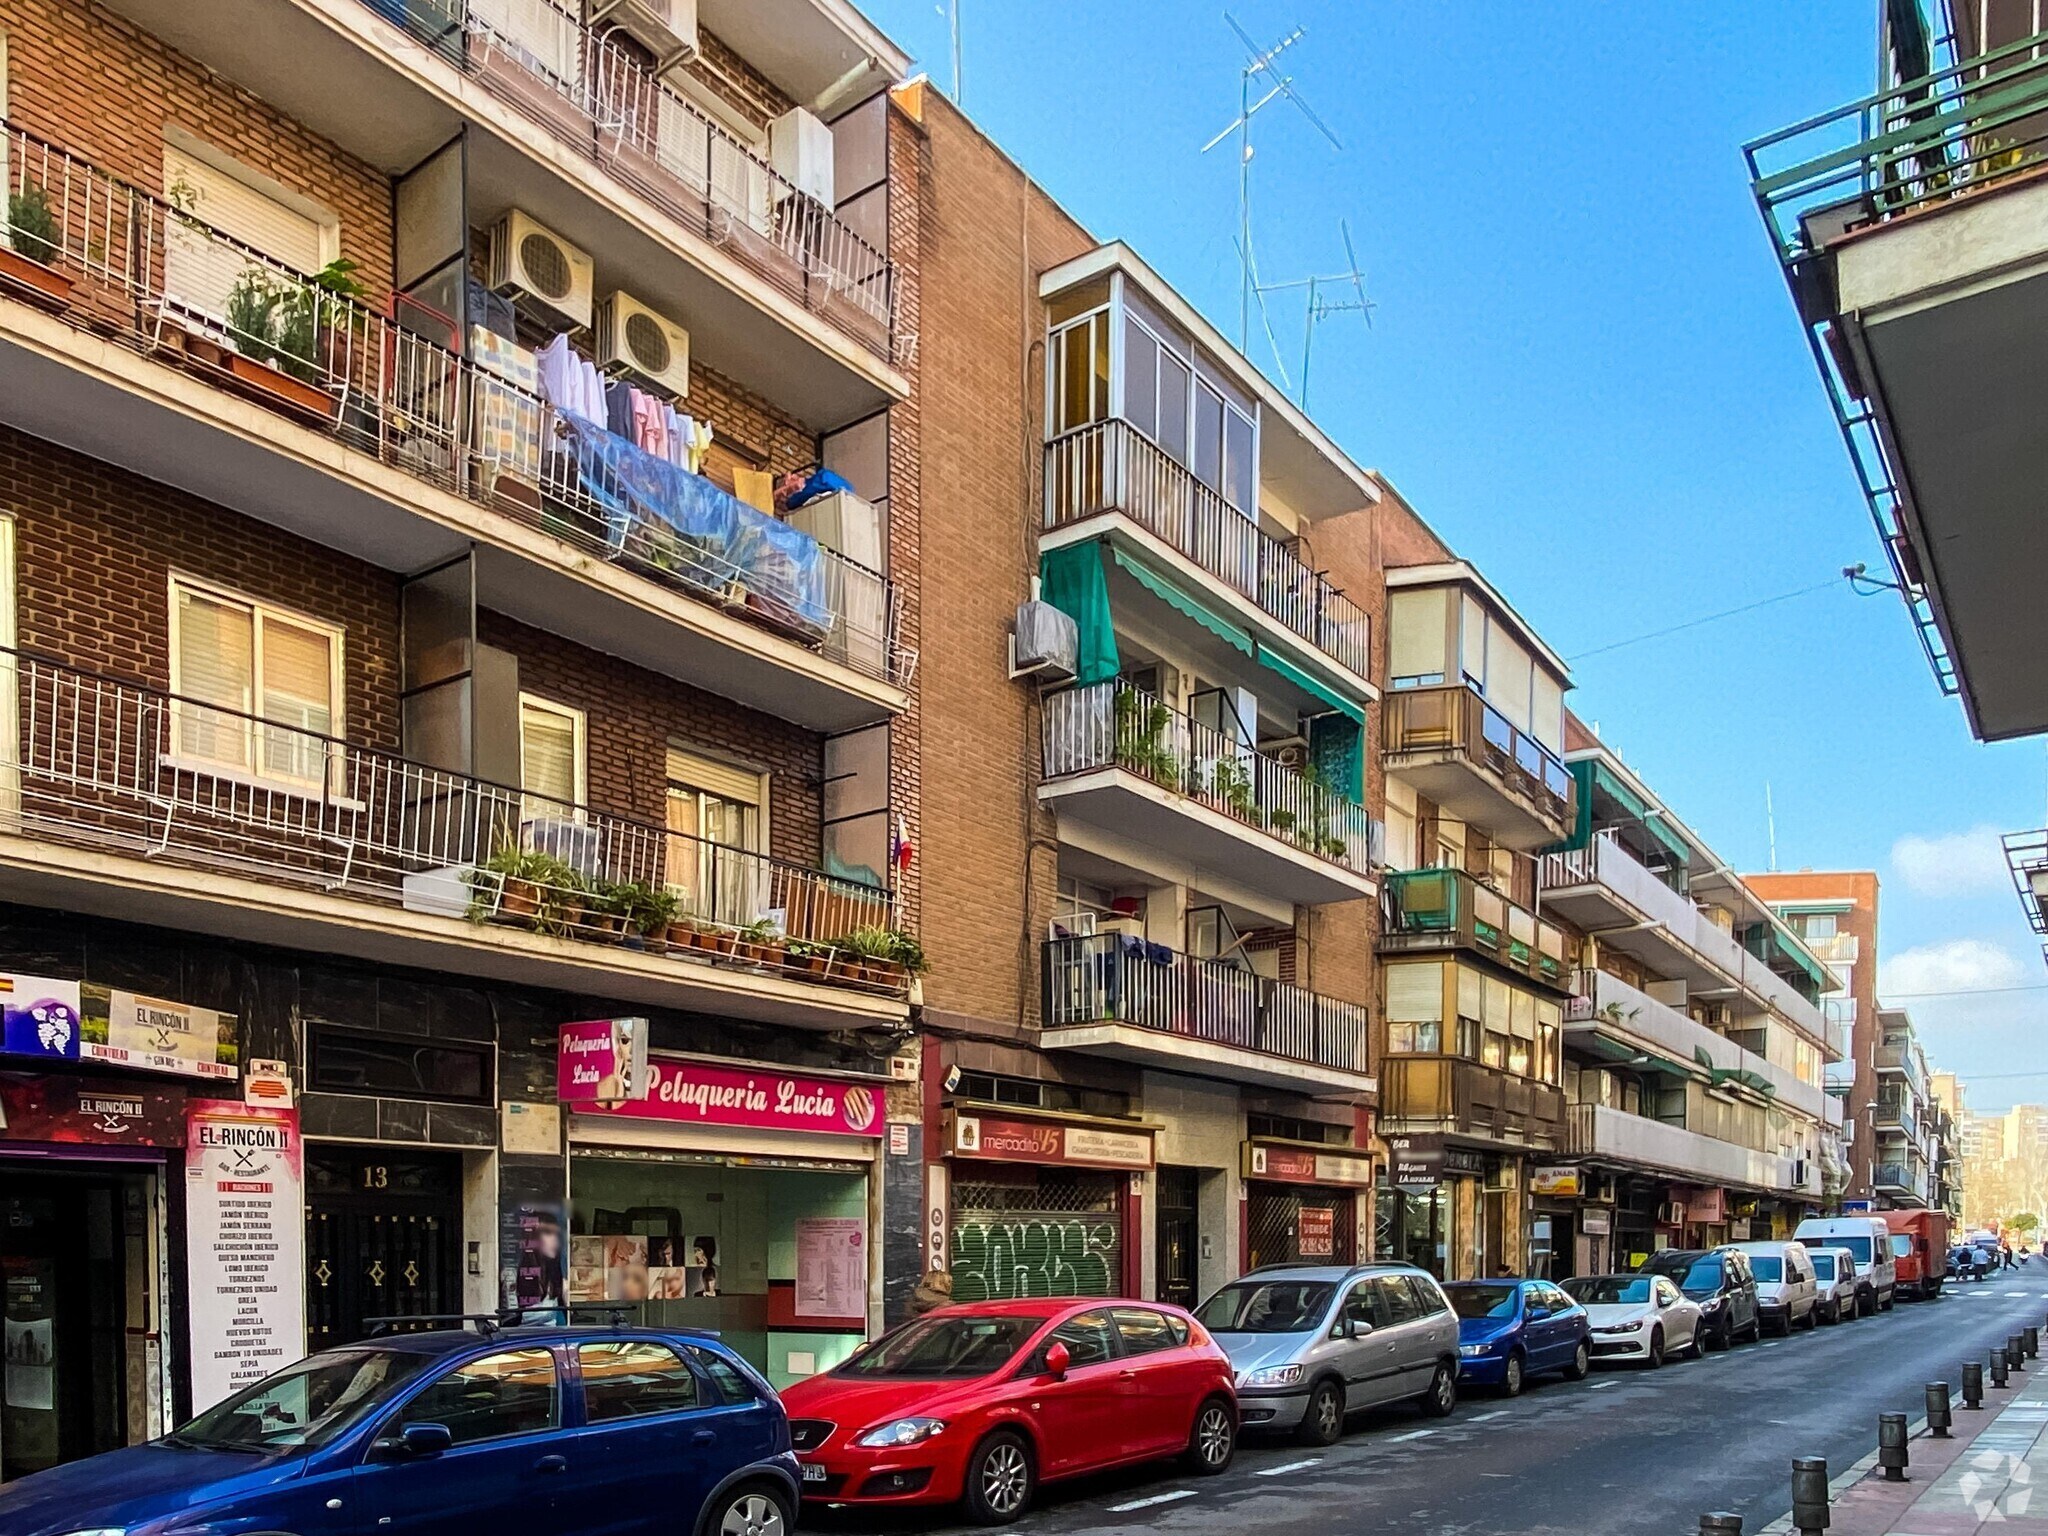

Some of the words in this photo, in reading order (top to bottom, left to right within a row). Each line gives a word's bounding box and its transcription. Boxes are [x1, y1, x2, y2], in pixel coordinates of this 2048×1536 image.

[137, 1007, 148, 1023] EL
[150, 1010, 182, 1030] RINCÓN
[572, 1064, 600, 1085] Lucia
[80, 1099, 94, 1112] EL
[95, 1100, 133, 1115] RINCÓN
[775, 1080, 836, 1117] Lucia
[199, 1126, 218, 1145] EL
[221, 1126, 275, 1148] RINCÓN
[279, 1130, 288, 1149] II
[983, 1136, 1040, 1153] mercadito
[364, 1166, 388, 1188] 13
